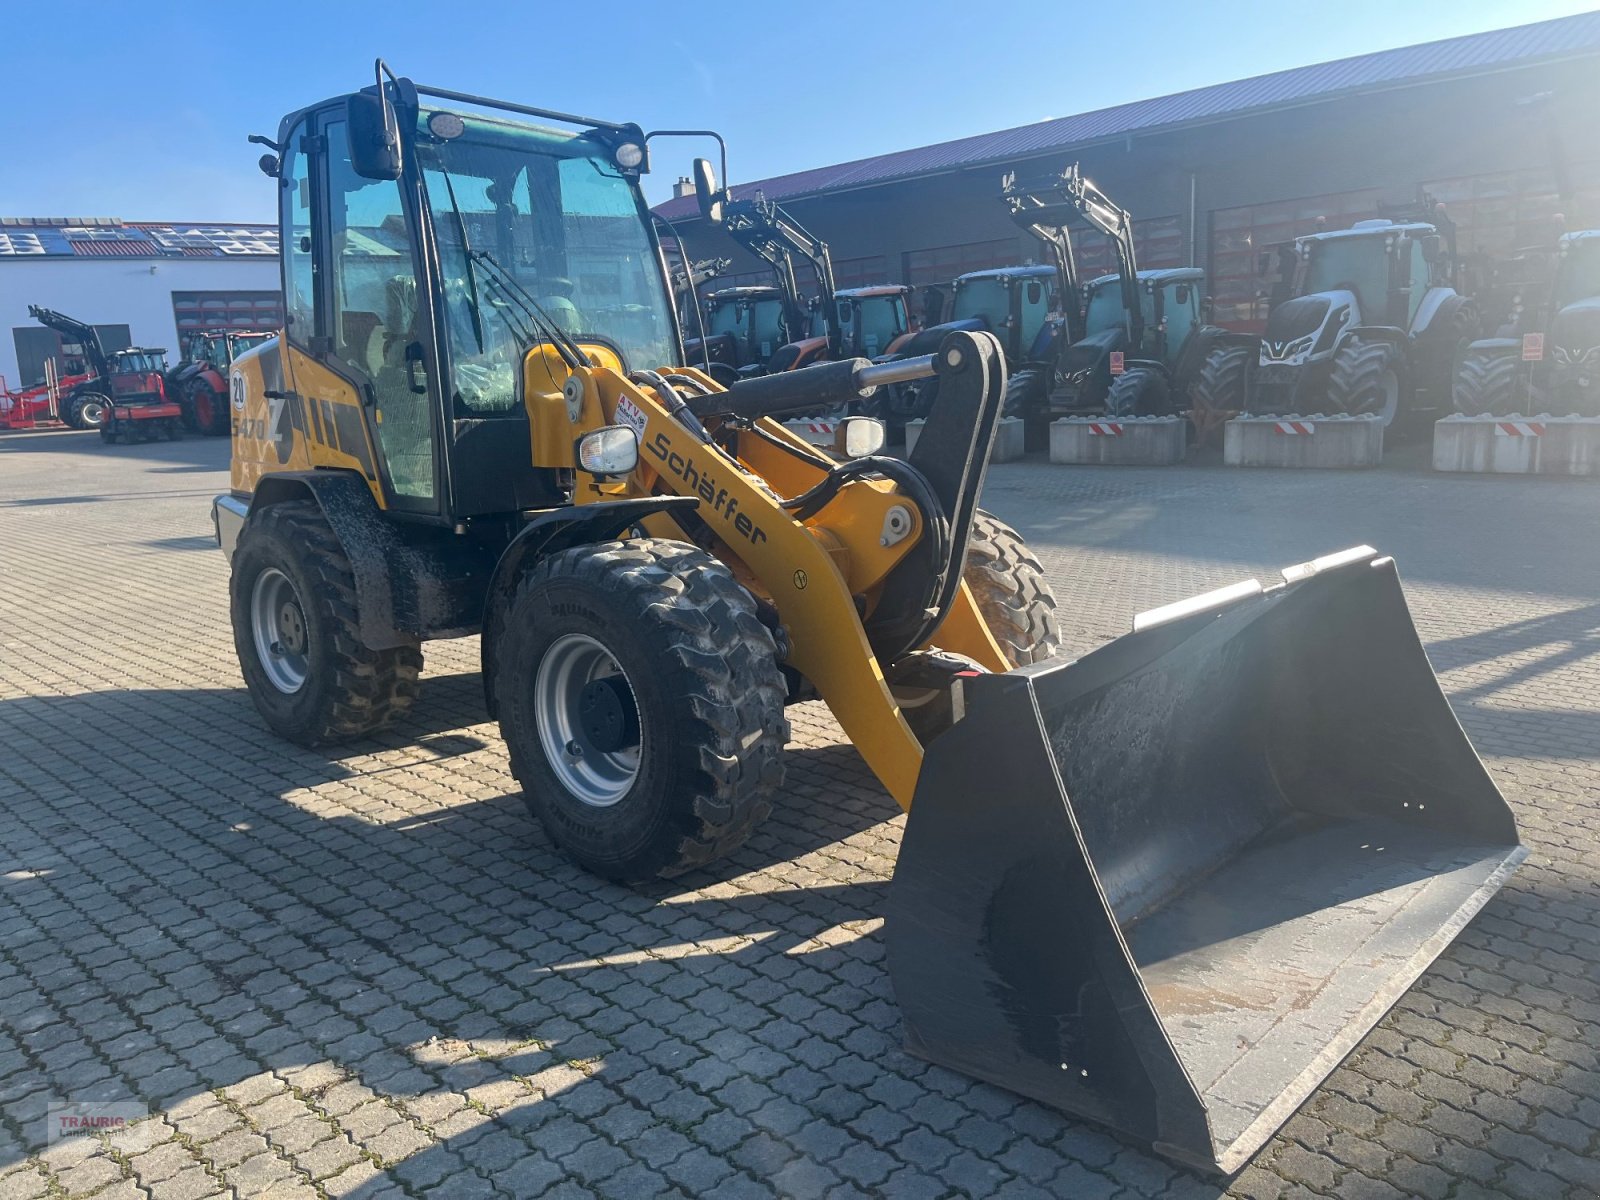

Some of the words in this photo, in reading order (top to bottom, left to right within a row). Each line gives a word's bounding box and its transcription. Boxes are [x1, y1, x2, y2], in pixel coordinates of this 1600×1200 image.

[233, 377, 244, 404] 20
[232, 417, 265, 440] 5470
[645, 433, 767, 545] Schäffer
